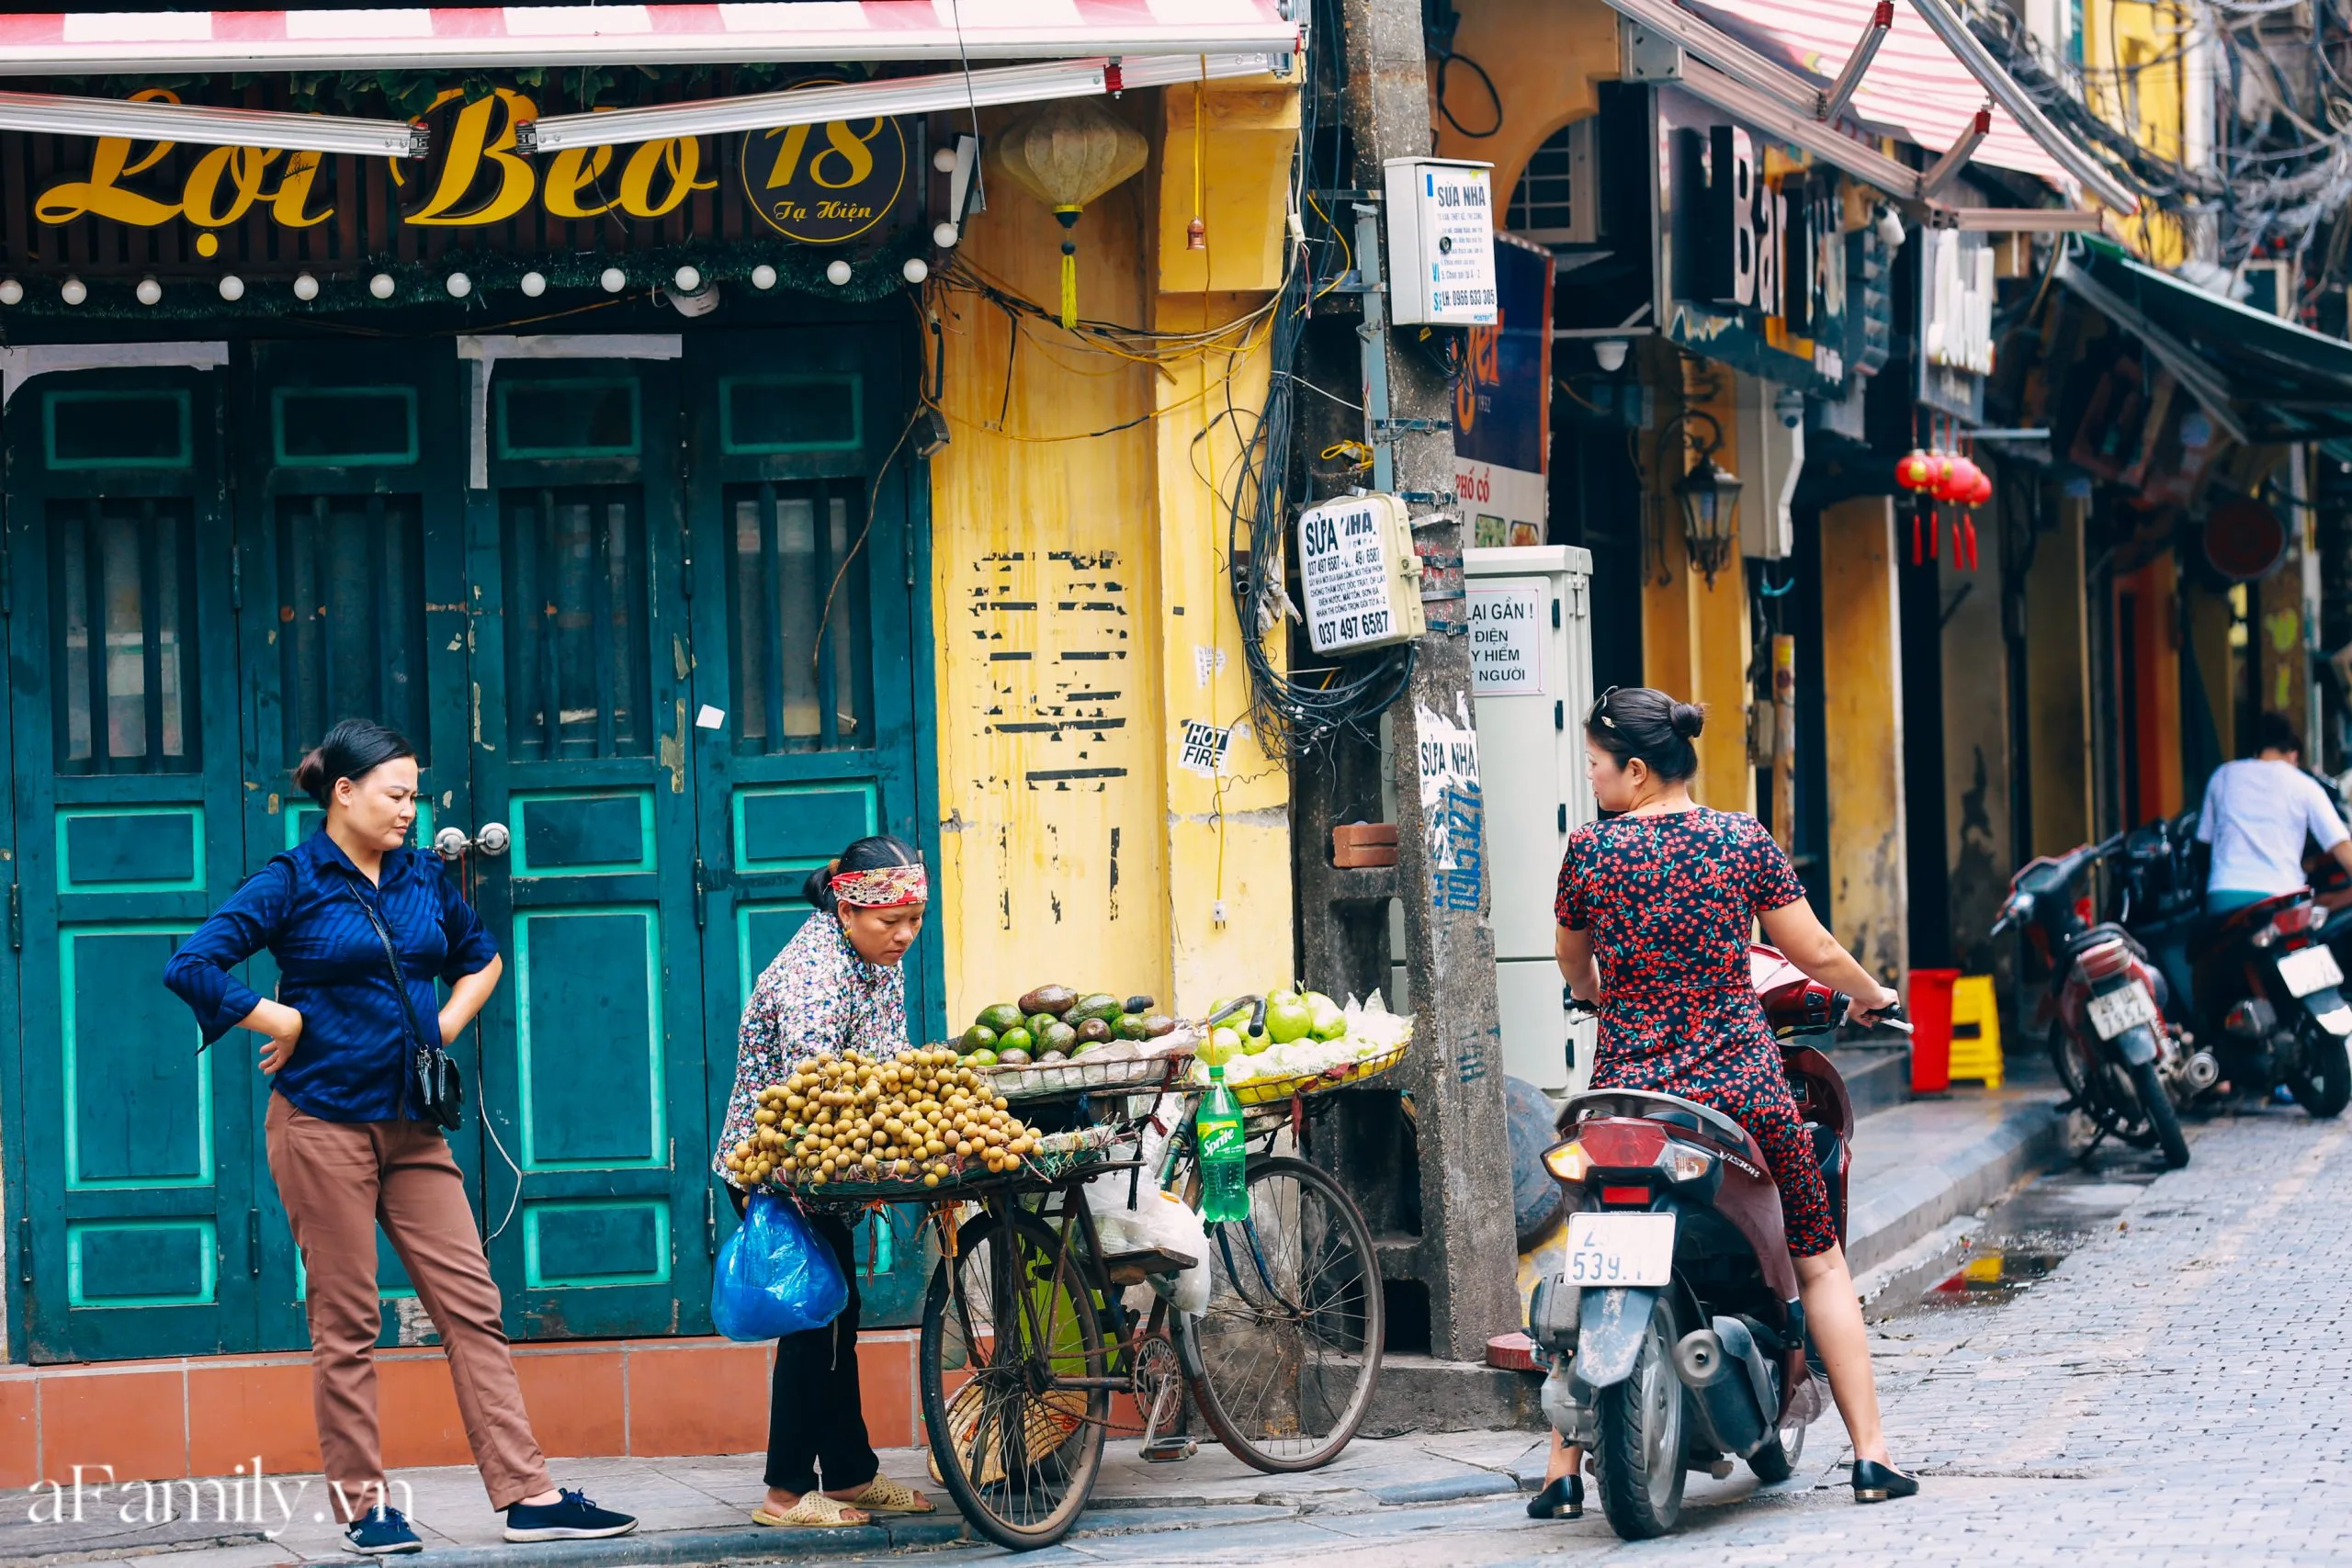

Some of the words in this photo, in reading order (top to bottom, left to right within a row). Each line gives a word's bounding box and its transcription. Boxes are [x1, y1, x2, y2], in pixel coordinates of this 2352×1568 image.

[764, 117, 885, 189] 18
[1437, 181, 1460, 208] SỬA
[1463, 182, 1487, 207] NHÀ
[774, 200, 808, 222] Tạ
[816, 200, 872, 222] Hiện
[1470, 289, 1482, 305] 633
[1483, 288, 1496, 305] 305
[1455, 466, 1475, 501] PHỐ
[1476, 466, 1490, 503] CỔ
[1306, 512, 1339, 558] SỬA
[1307, 559, 1317, 577] 037
[1317, 558, 1327, 574] 497
[1328, 555, 1340, 572] 6587
[1467, 603, 1487, 625] ẠI
[1491, 595, 1524, 621] GẦN
[1318, 620, 1337, 646] 037
[1340, 615, 1359, 640] 497
[1362, 610, 1389, 636] 6587
[1475, 627, 1509, 646] ĐIỆN
[1485, 643, 1521, 662] HIỂM
[1479, 666, 1526, 682] NGƯỜI
[1188, 725, 1227, 749] HOT
[1183, 746, 1224, 768] FIRE
[1421, 733, 1446, 777] SỬA
[1451, 733, 1476, 777] NHÀ
[1204, 1129, 1235, 1157] Sprite
